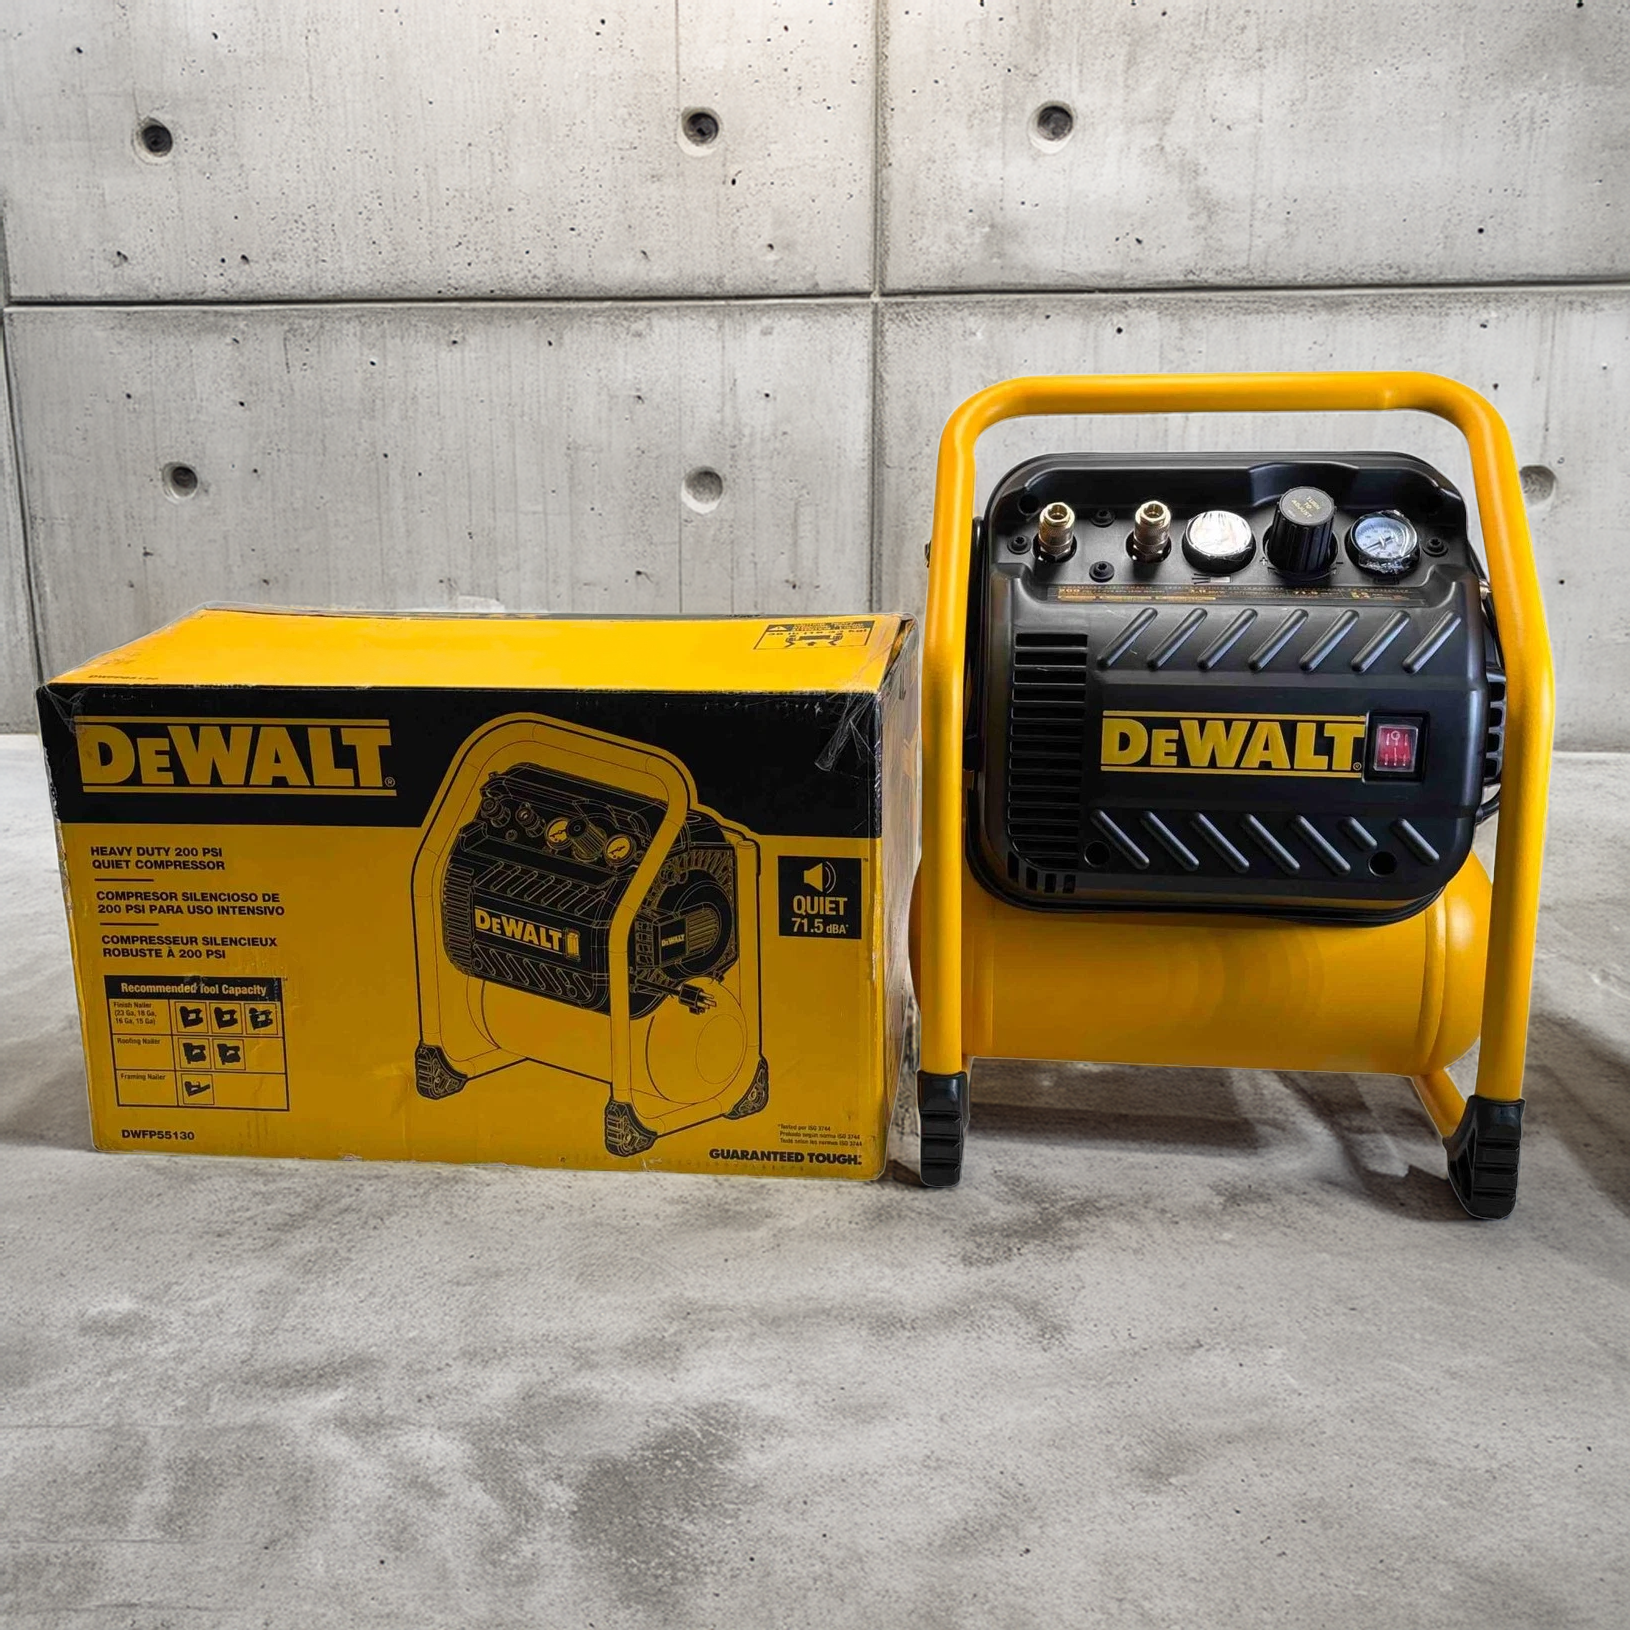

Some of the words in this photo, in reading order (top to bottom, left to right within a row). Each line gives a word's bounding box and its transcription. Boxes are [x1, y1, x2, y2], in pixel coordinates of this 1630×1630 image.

[90, 846, 132, 857] HEAVY
[136, 847, 171, 857] DUTY
[174, 847, 199, 857] 200
[202, 847, 223, 858] PSI
[92, 859, 131, 870] QUIET
[135, 860, 225, 870] COMPRESSOR
[96, 890, 179, 901] COMPRESOR
[181, 891, 259, 902] SILENCIOSO
[262, 893, 280, 903] DE
[98, 904, 122, 914] 200
[125, 905, 146, 914] PSI
[149, 905, 184, 915] PARA
[187, 905, 214, 915] USO
[217, 905, 285, 916] INTENSIVO
[792, 895, 848, 916] QUIET
[791, 917, 824, 933] 71.5
[101, 934, 199, 946] COMPRESSEUR
[202, 936, 278, 947] SILENCIEUX
[103, 947, 162, 958] ROBUSTE
[166, 946, 176, 958] À
[179, 949, 202, 959] 200
[206, 949, 226, 959] PSI
[120, 982, 197, 994] Recommended
[221, 984, 267, 997] Capacity
[117, 1037, 141, 1045] Roofing
[120, 1073, 146, 1082] Framing
[147, 1073, 166, 1081] Nailer
[121, 1129, 195, 1140] DWFP55130
[709, 1148, 804, 1163] GUARANTEED
